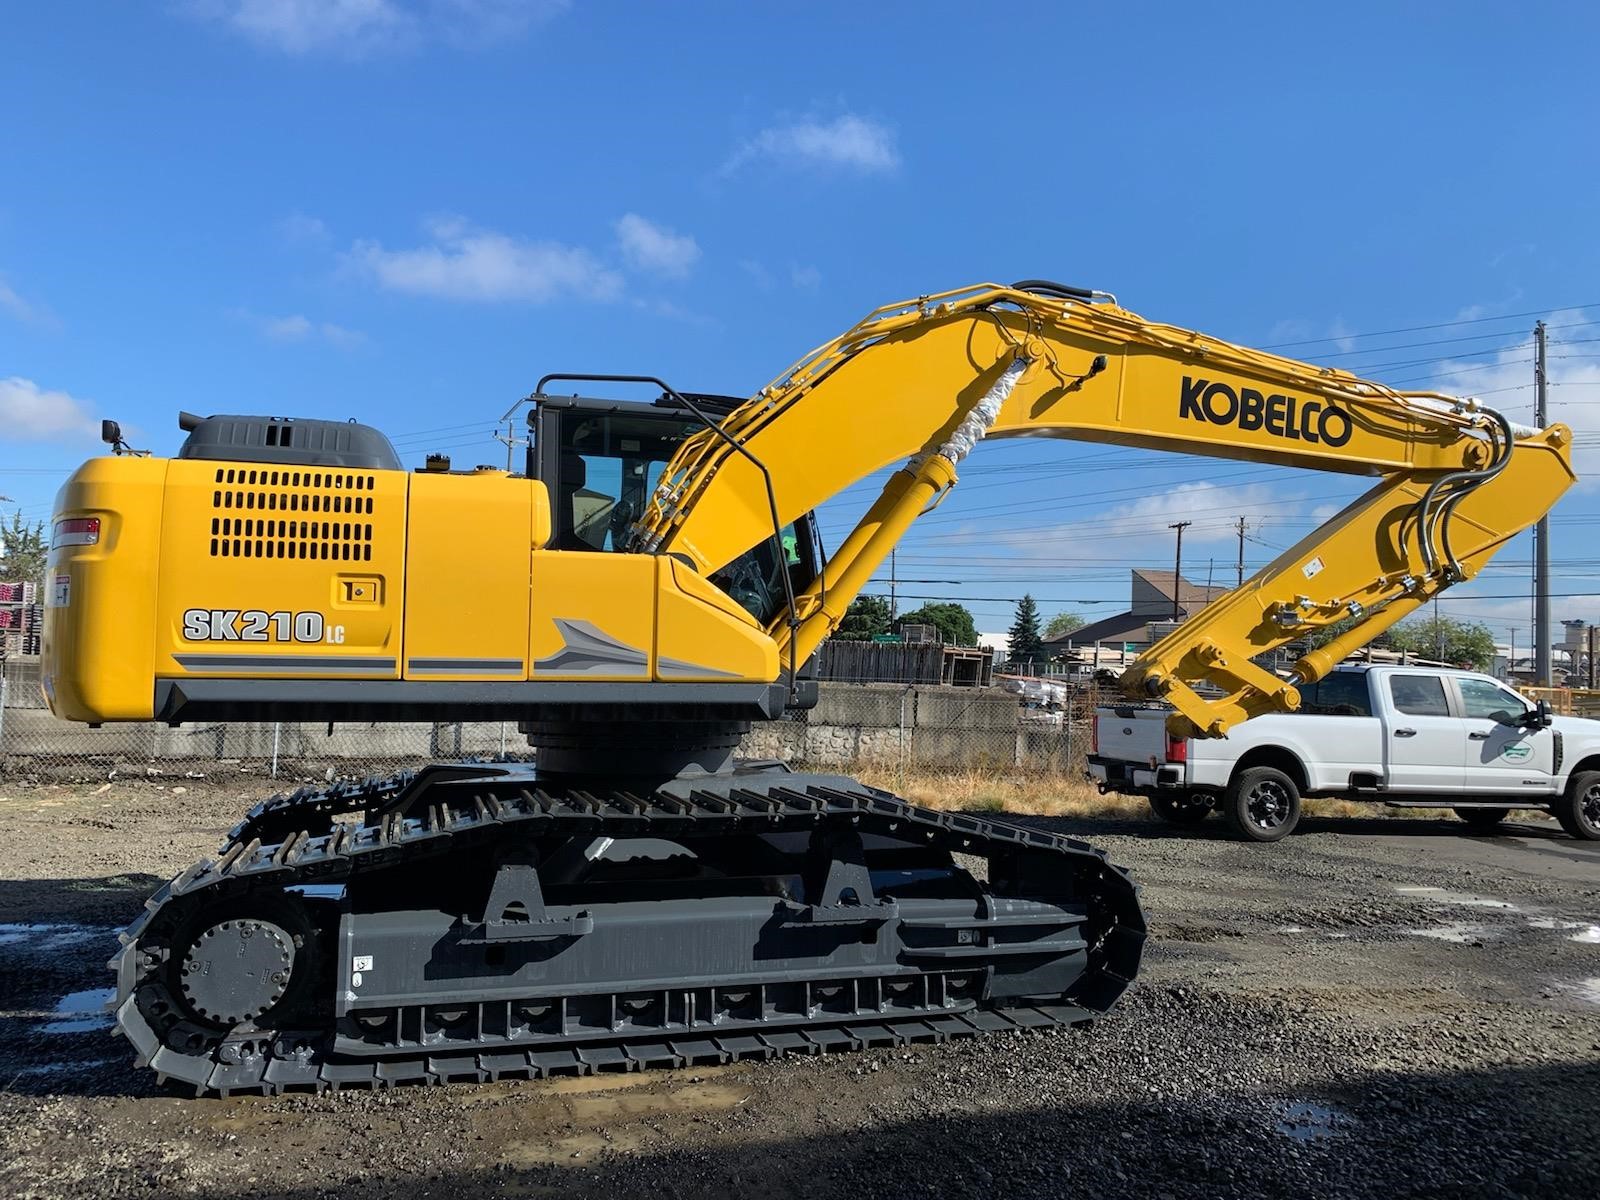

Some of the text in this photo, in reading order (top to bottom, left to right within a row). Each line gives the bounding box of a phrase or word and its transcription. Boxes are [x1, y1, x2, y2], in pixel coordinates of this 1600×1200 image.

[1179, 376, 1353, 447] KOBELCO
[183, 608, 345, 644] SK210 LC
